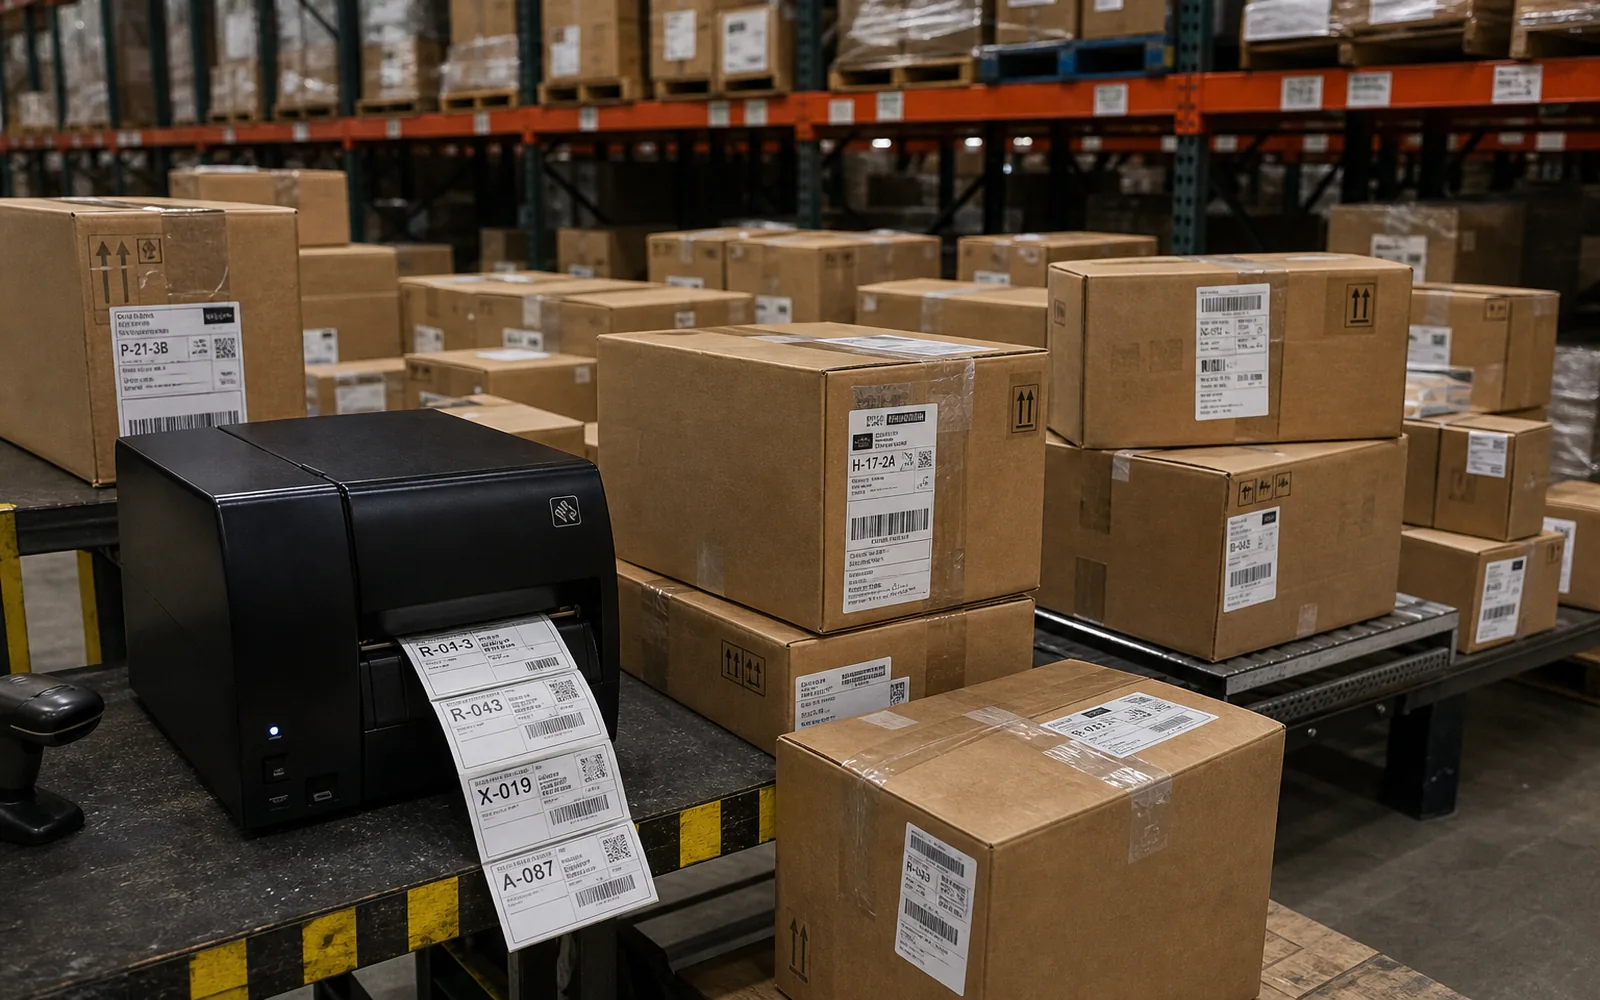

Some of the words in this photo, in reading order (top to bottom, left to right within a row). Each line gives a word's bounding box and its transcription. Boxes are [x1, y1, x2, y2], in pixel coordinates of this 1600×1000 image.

[120, 341, 169, 357] P-21-3B
[852, 454, 896, 472] H-17-2A
[449, 698, 504, 723] R-043
[477, 776, 533, 806] X-019
[503, 859, 554, 892] A-087
